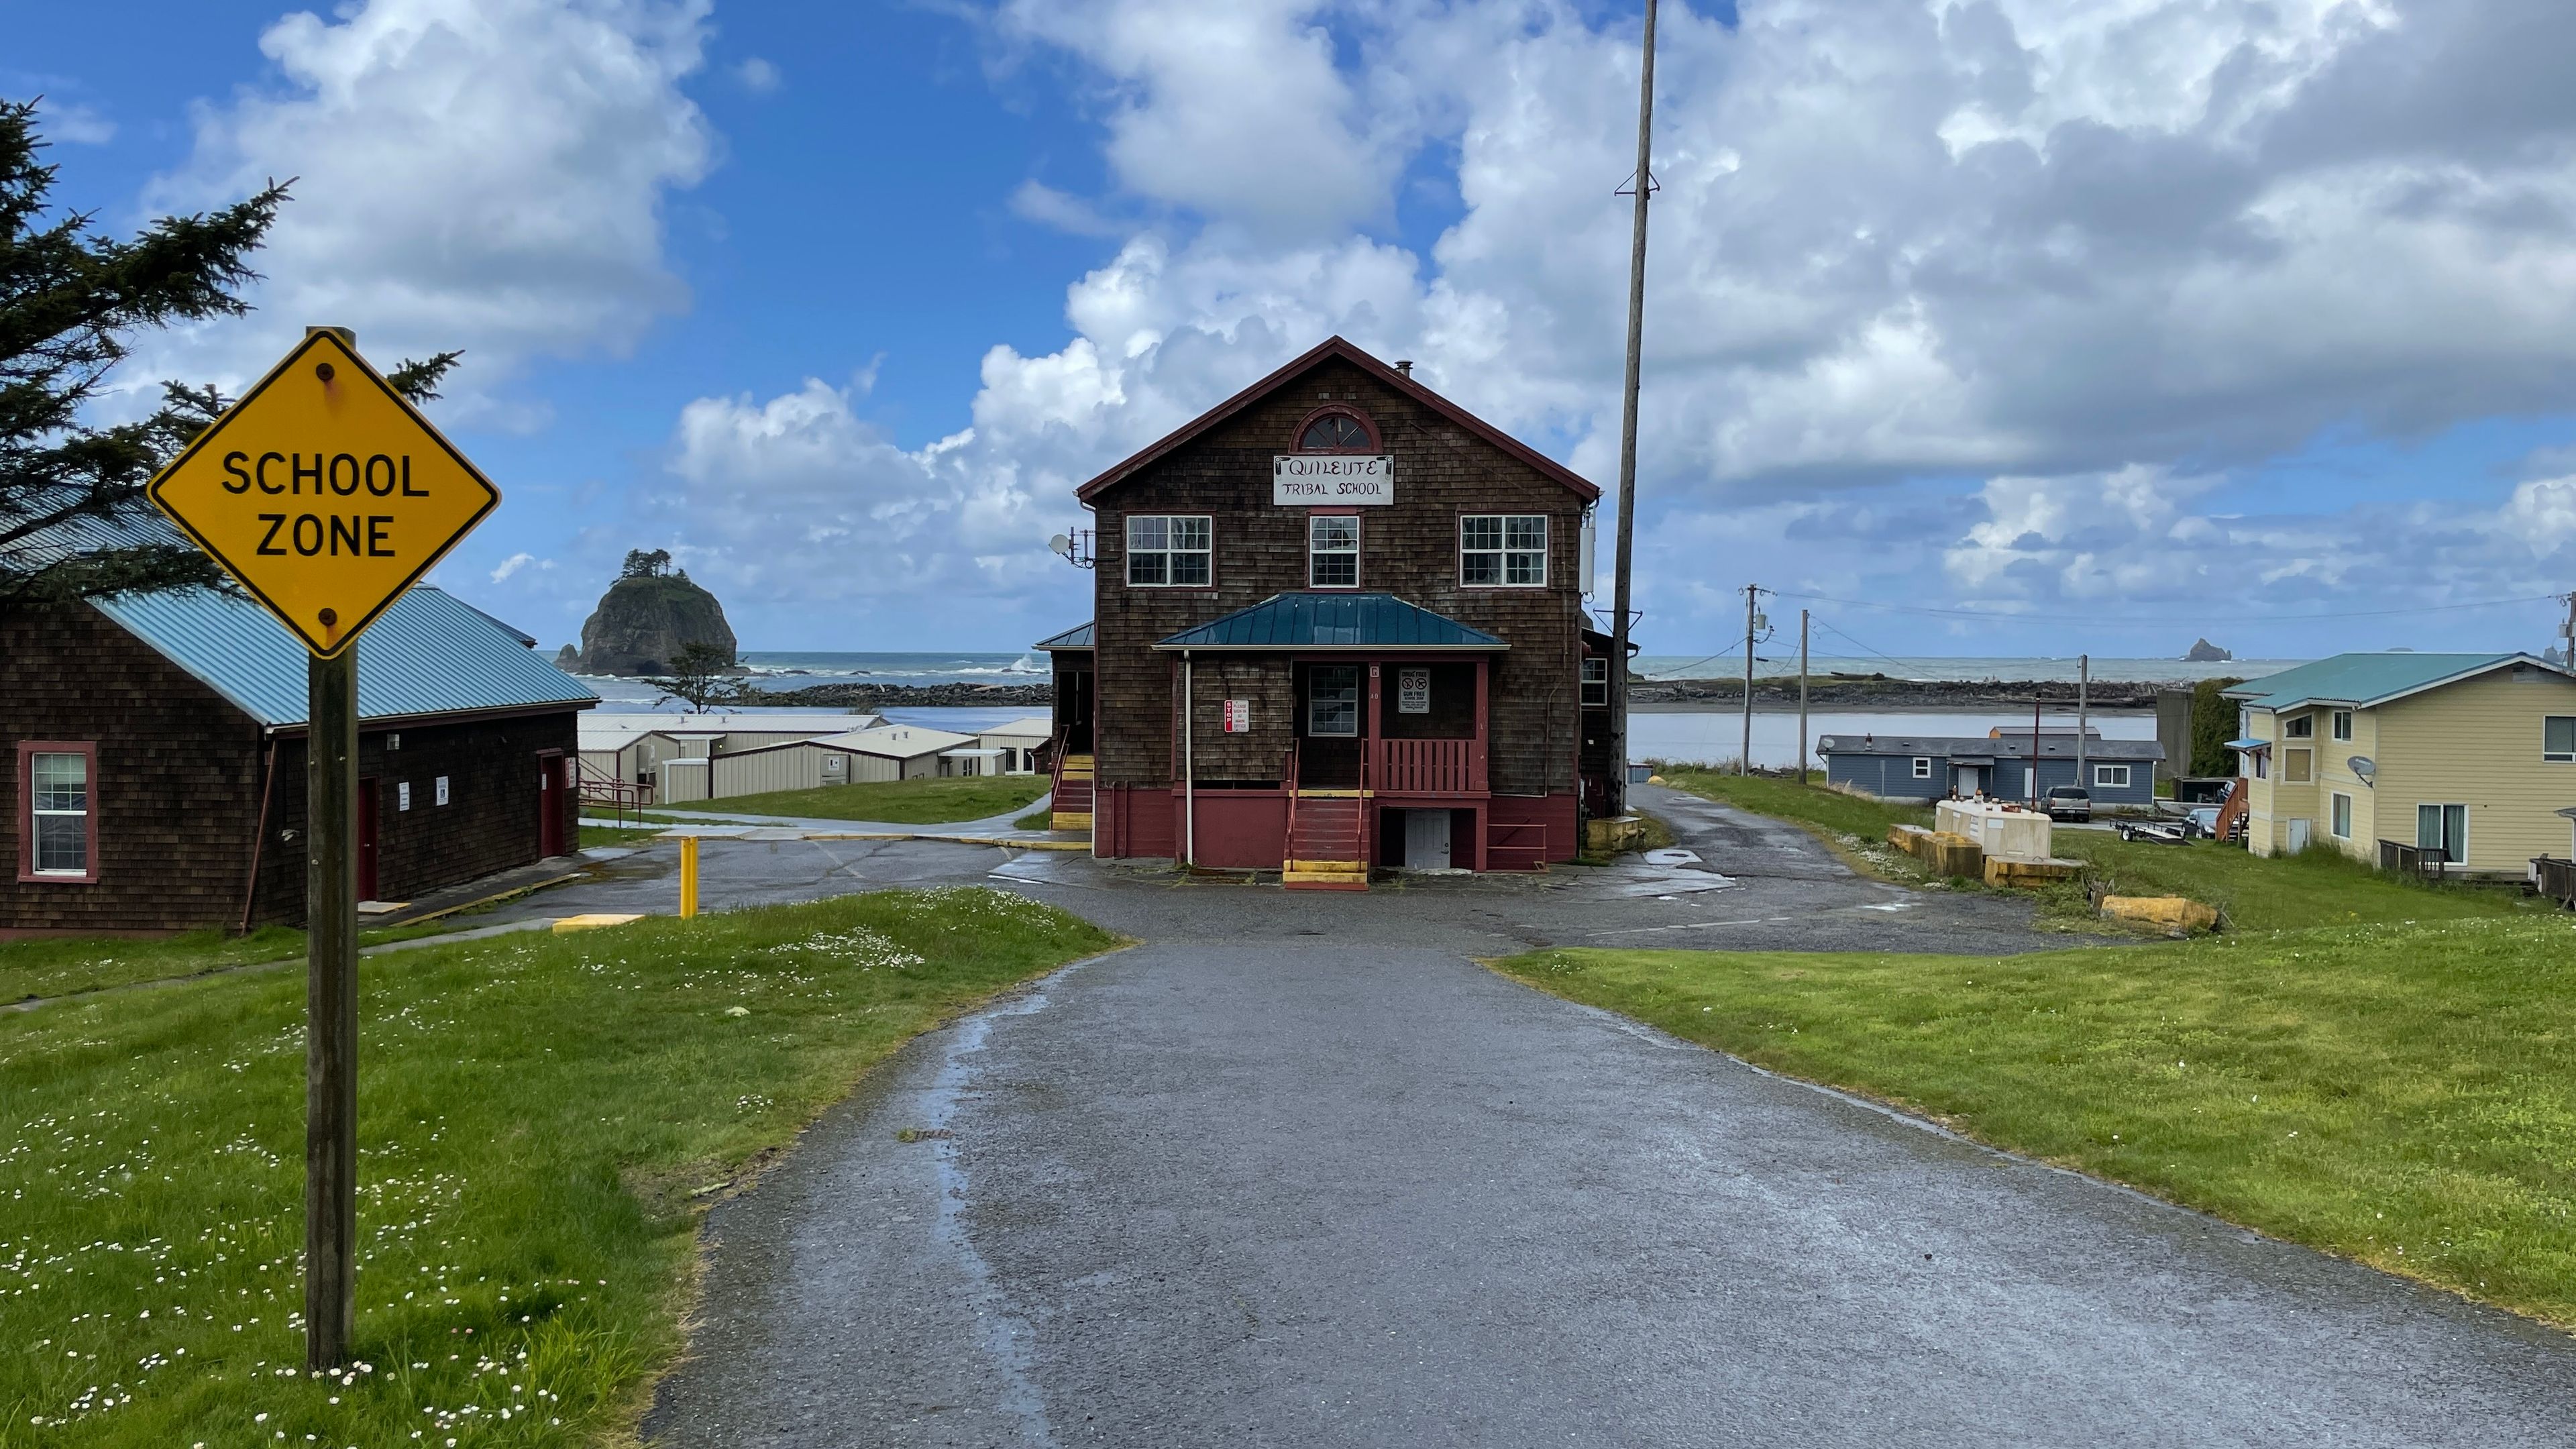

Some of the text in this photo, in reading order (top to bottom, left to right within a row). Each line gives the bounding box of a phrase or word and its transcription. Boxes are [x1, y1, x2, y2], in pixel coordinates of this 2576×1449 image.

[221, 451, 430, 497] SCHOOL
[1289, 460, 1379, 476] QUILEUTE
[1282, 482, 1382, 495] TRIBAL SCHOOL
[256, 513, 396, 557] ZONE
